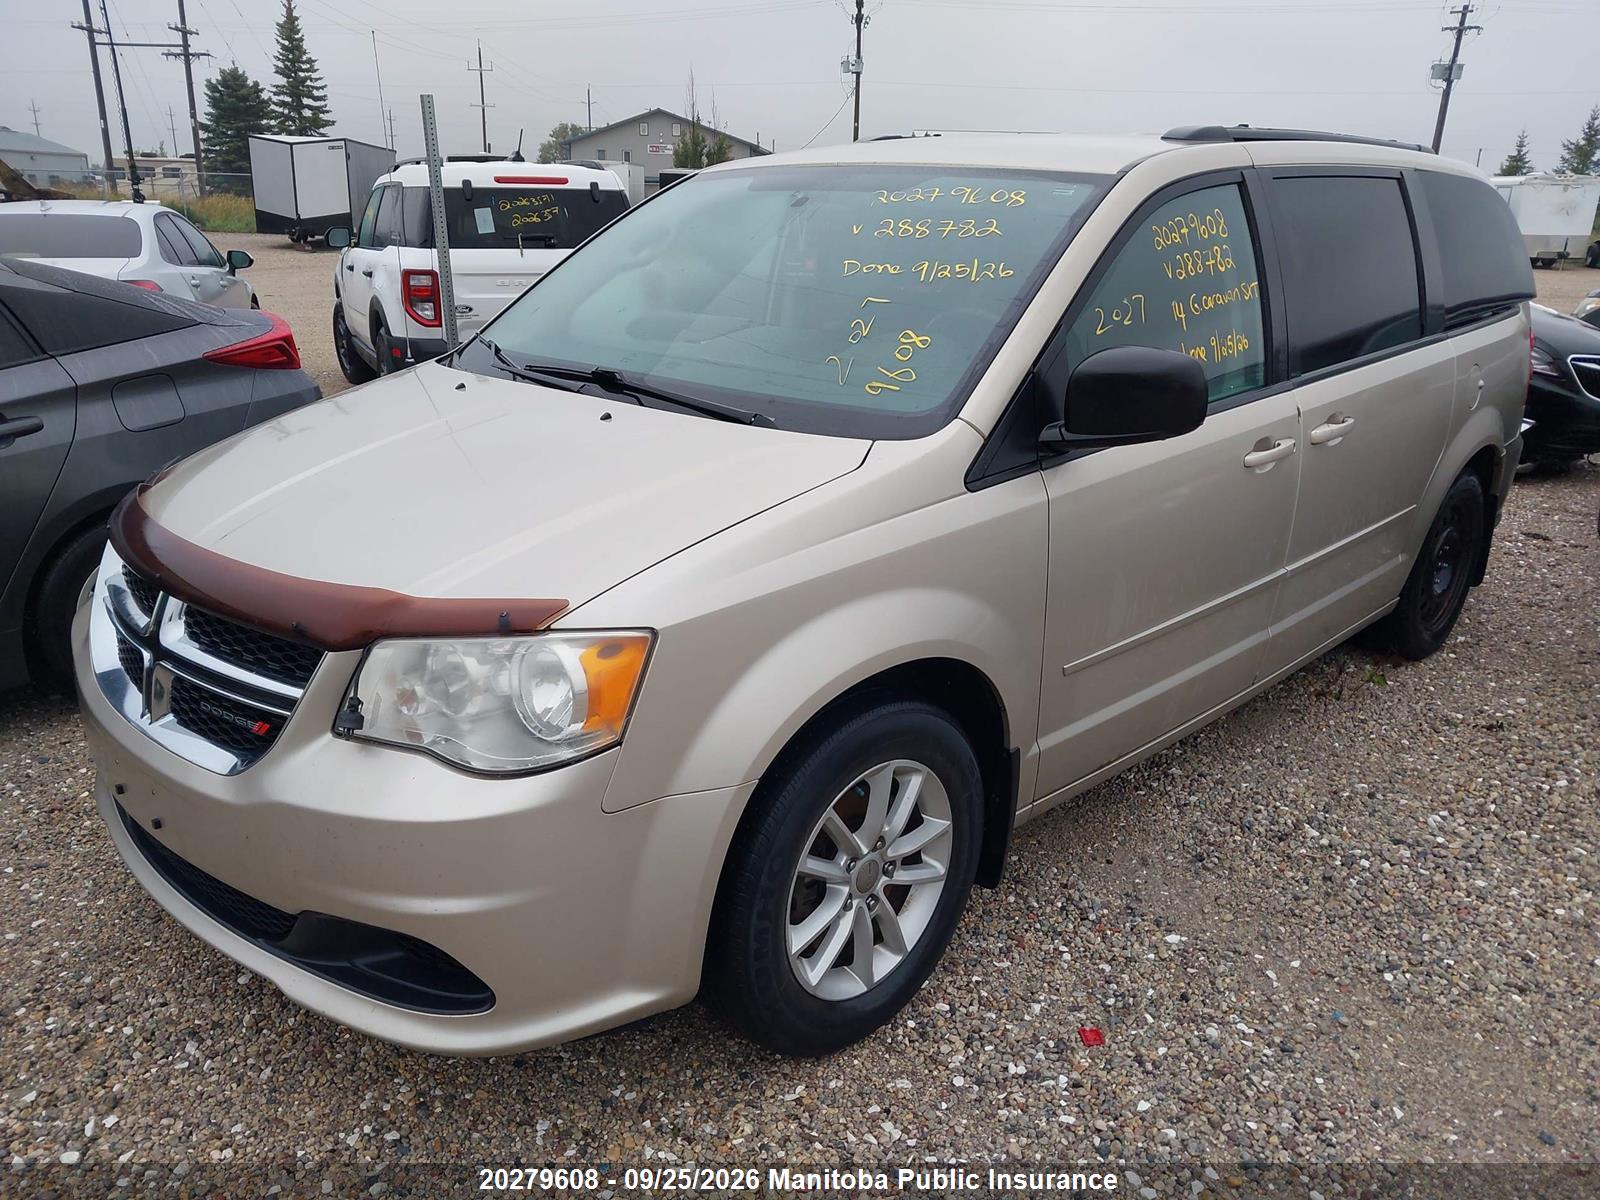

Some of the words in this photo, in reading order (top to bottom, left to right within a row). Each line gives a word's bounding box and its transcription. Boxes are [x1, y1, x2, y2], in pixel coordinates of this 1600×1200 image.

[874, 218, 1003, 239] 288782
[1152, 208, 1228, 250] 20279608
[842, 259, 904, 277] Done
[911, 258, 1015, 283] 9/25/26
[1095, 294, 1146, 335] 2027
[1172, 300, 1187, 332] 14
[865, 329, 931, 395] 9608
[1210, 328, 1249, 363] 9/25/26
[200, 702, 258, 730] DODGE
